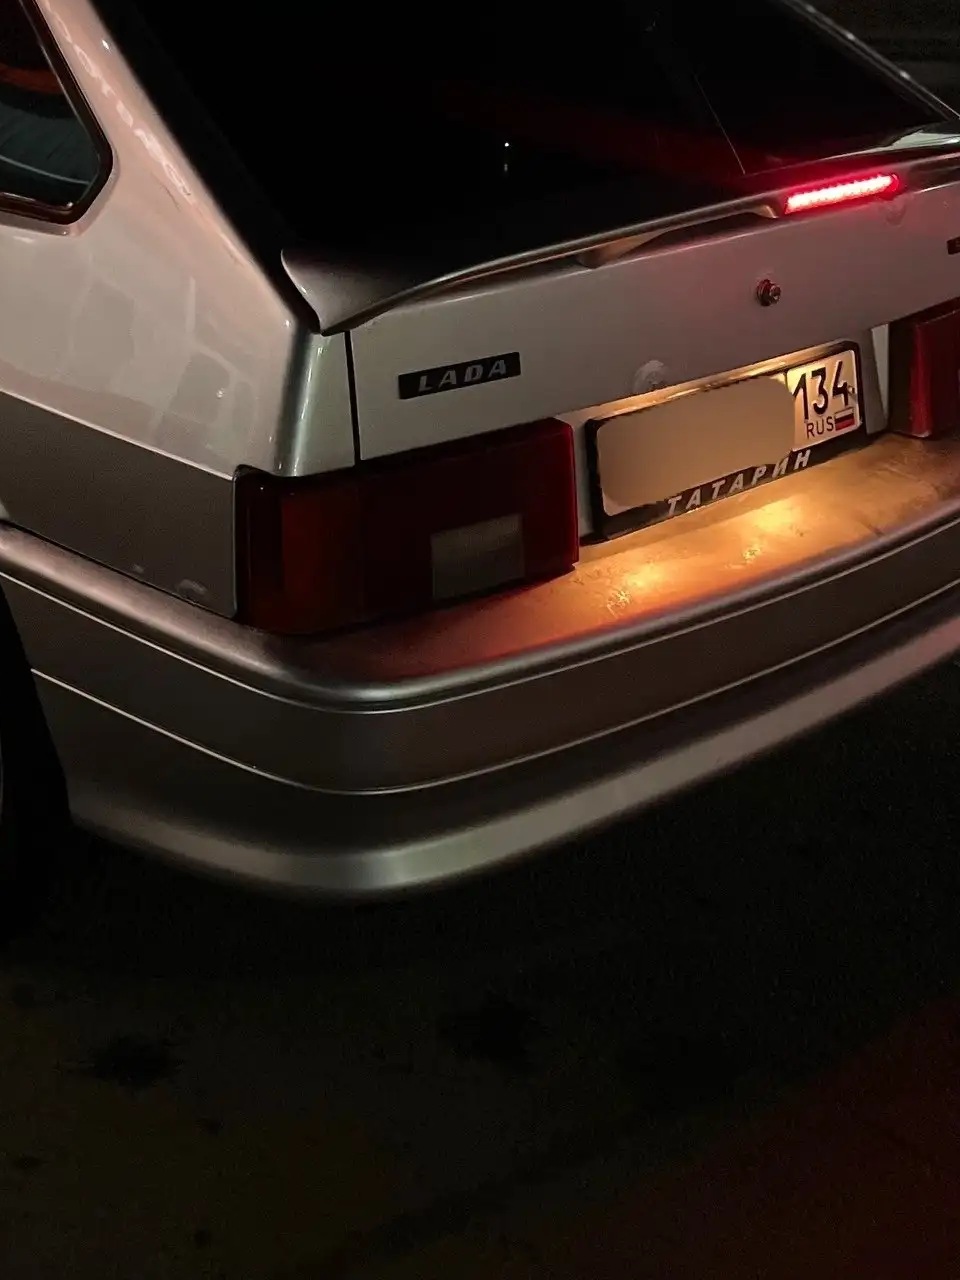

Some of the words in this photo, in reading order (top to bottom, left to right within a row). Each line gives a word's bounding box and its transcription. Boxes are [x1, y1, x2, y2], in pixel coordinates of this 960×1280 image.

[418, 359, 507, 392] LADA
[792, 360, 849, 420] 134
[806, 416, 835, 440] RUS
[667, 449, 811, 516] ТАТАРИН
